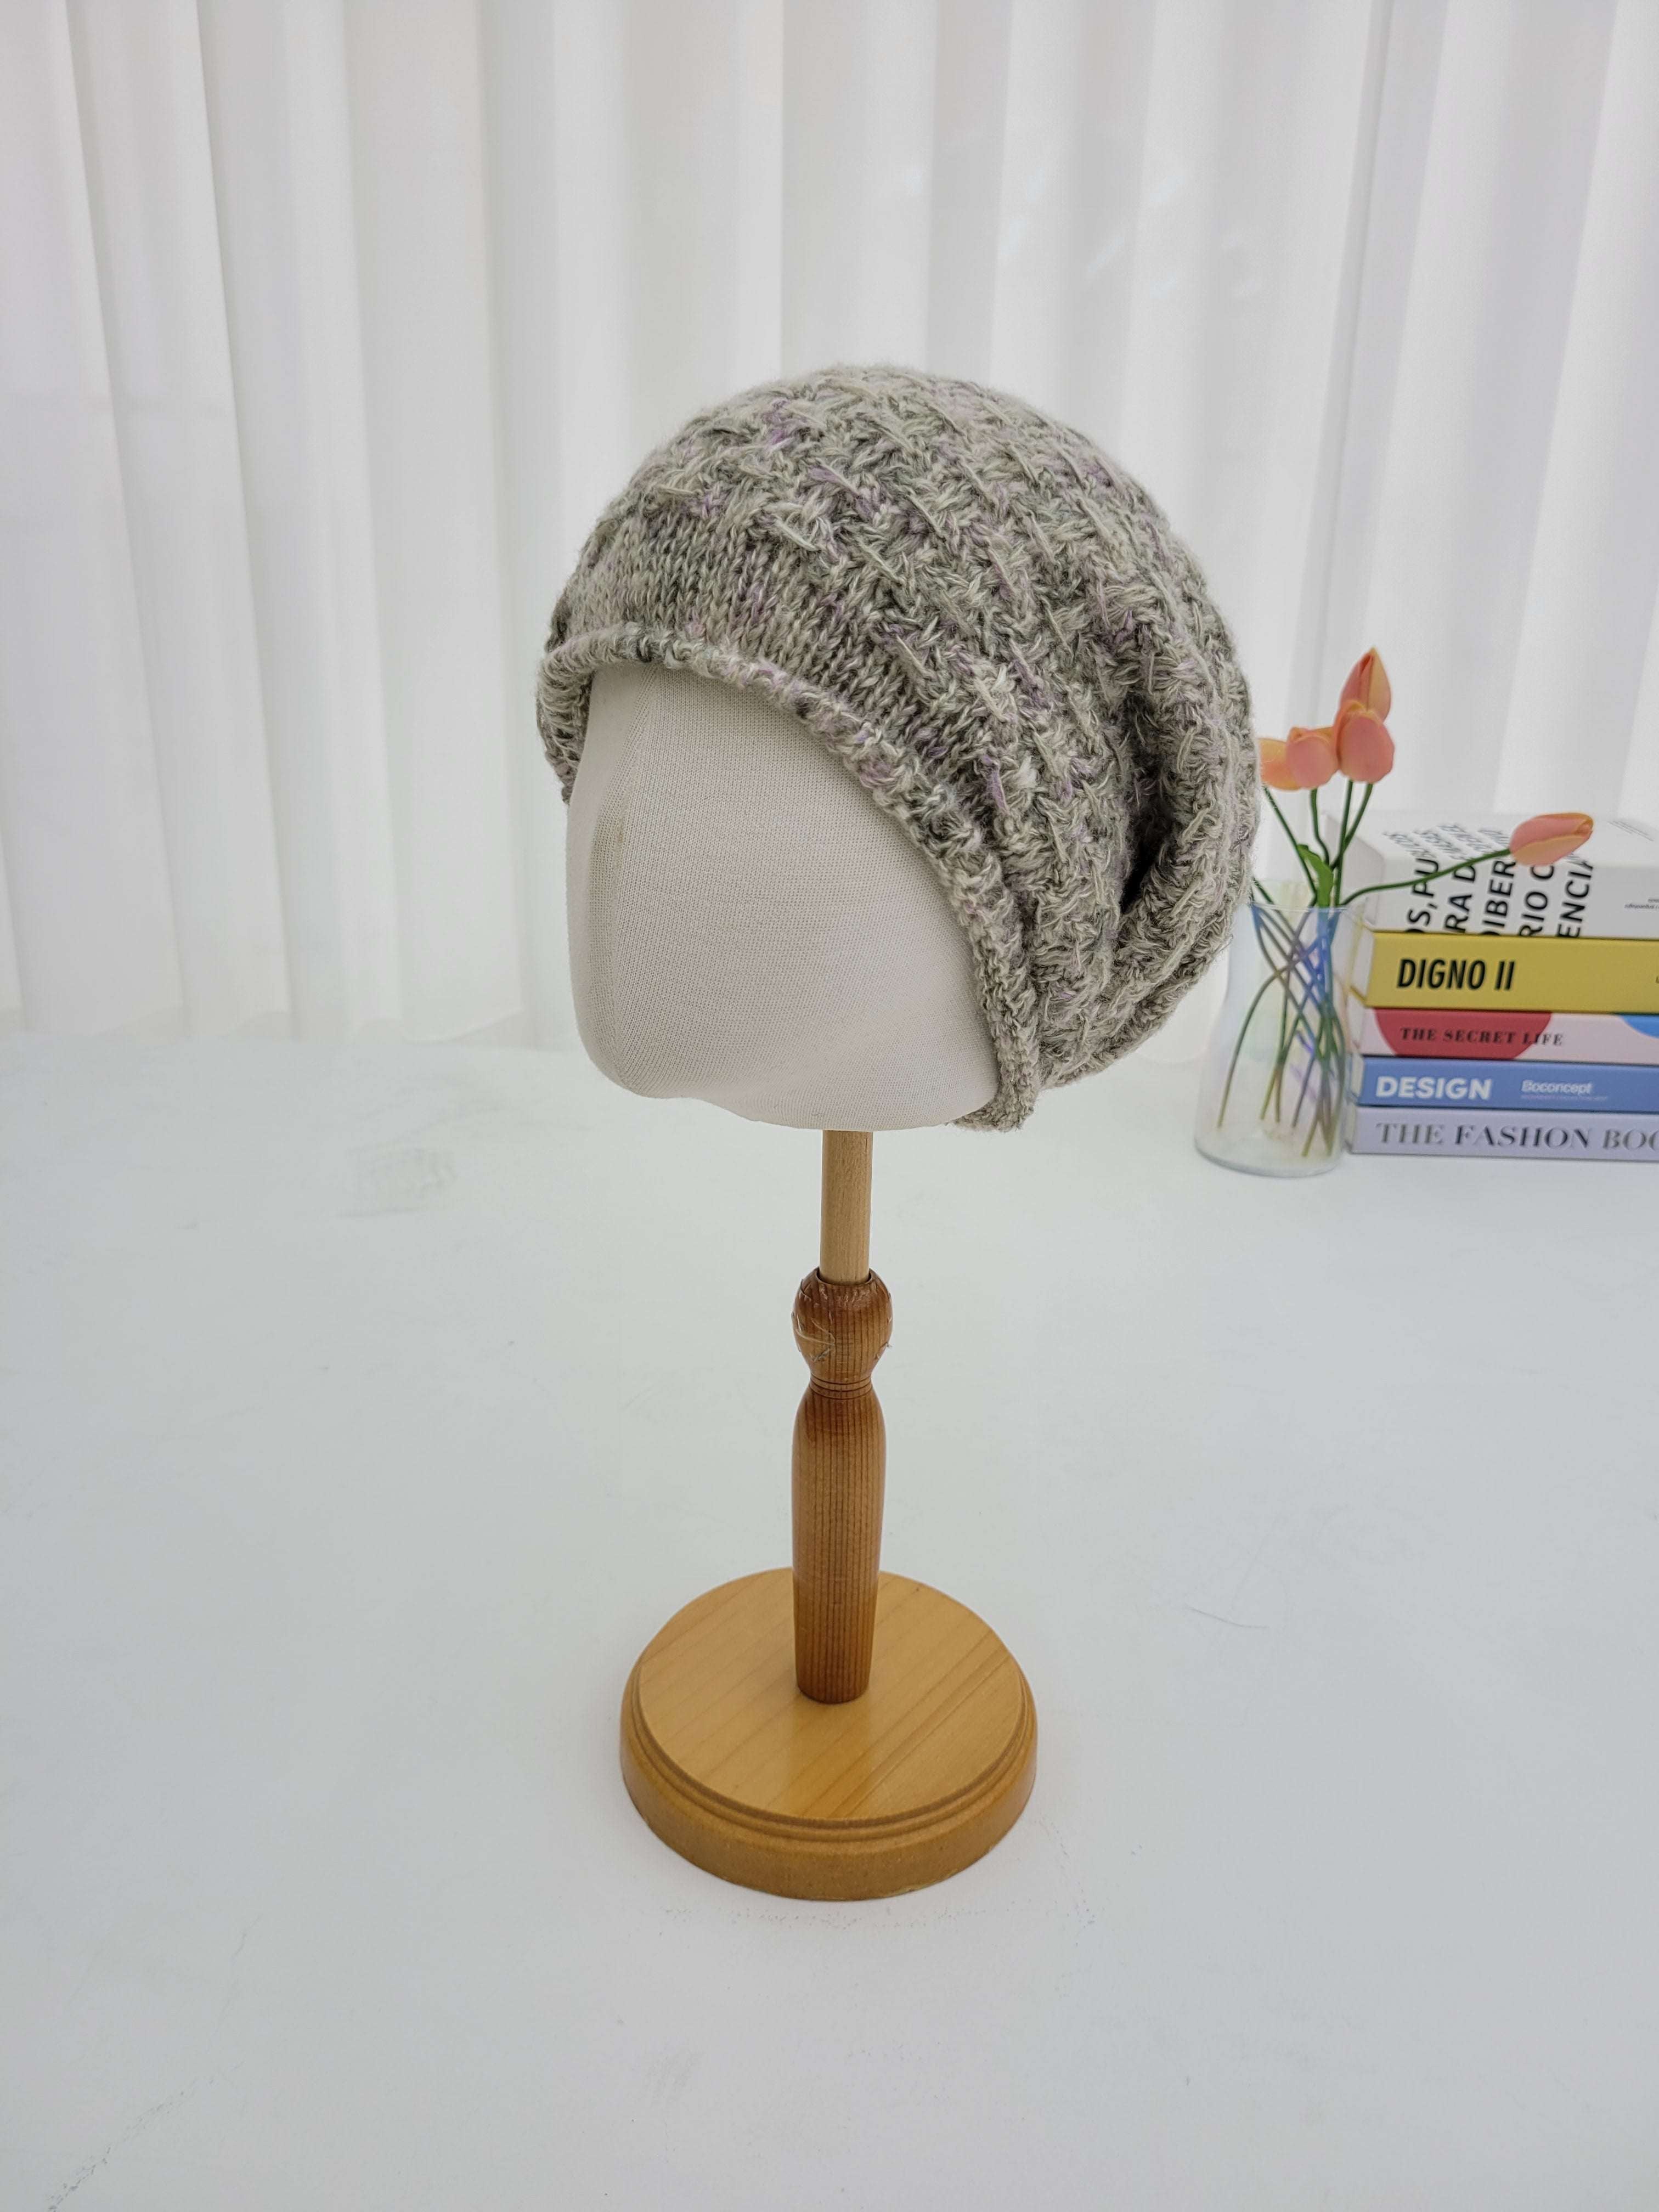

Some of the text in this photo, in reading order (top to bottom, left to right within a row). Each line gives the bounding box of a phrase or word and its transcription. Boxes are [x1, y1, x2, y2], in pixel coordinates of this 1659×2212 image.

[1397, 958, 1515, 991] DIGNO II
[1401, 1027, 1564, 1046] THE SECRET LIFE
[1375, 1076, 1492, 1100] DESIGN
[1375, 1122, 1445, 1145] THE
